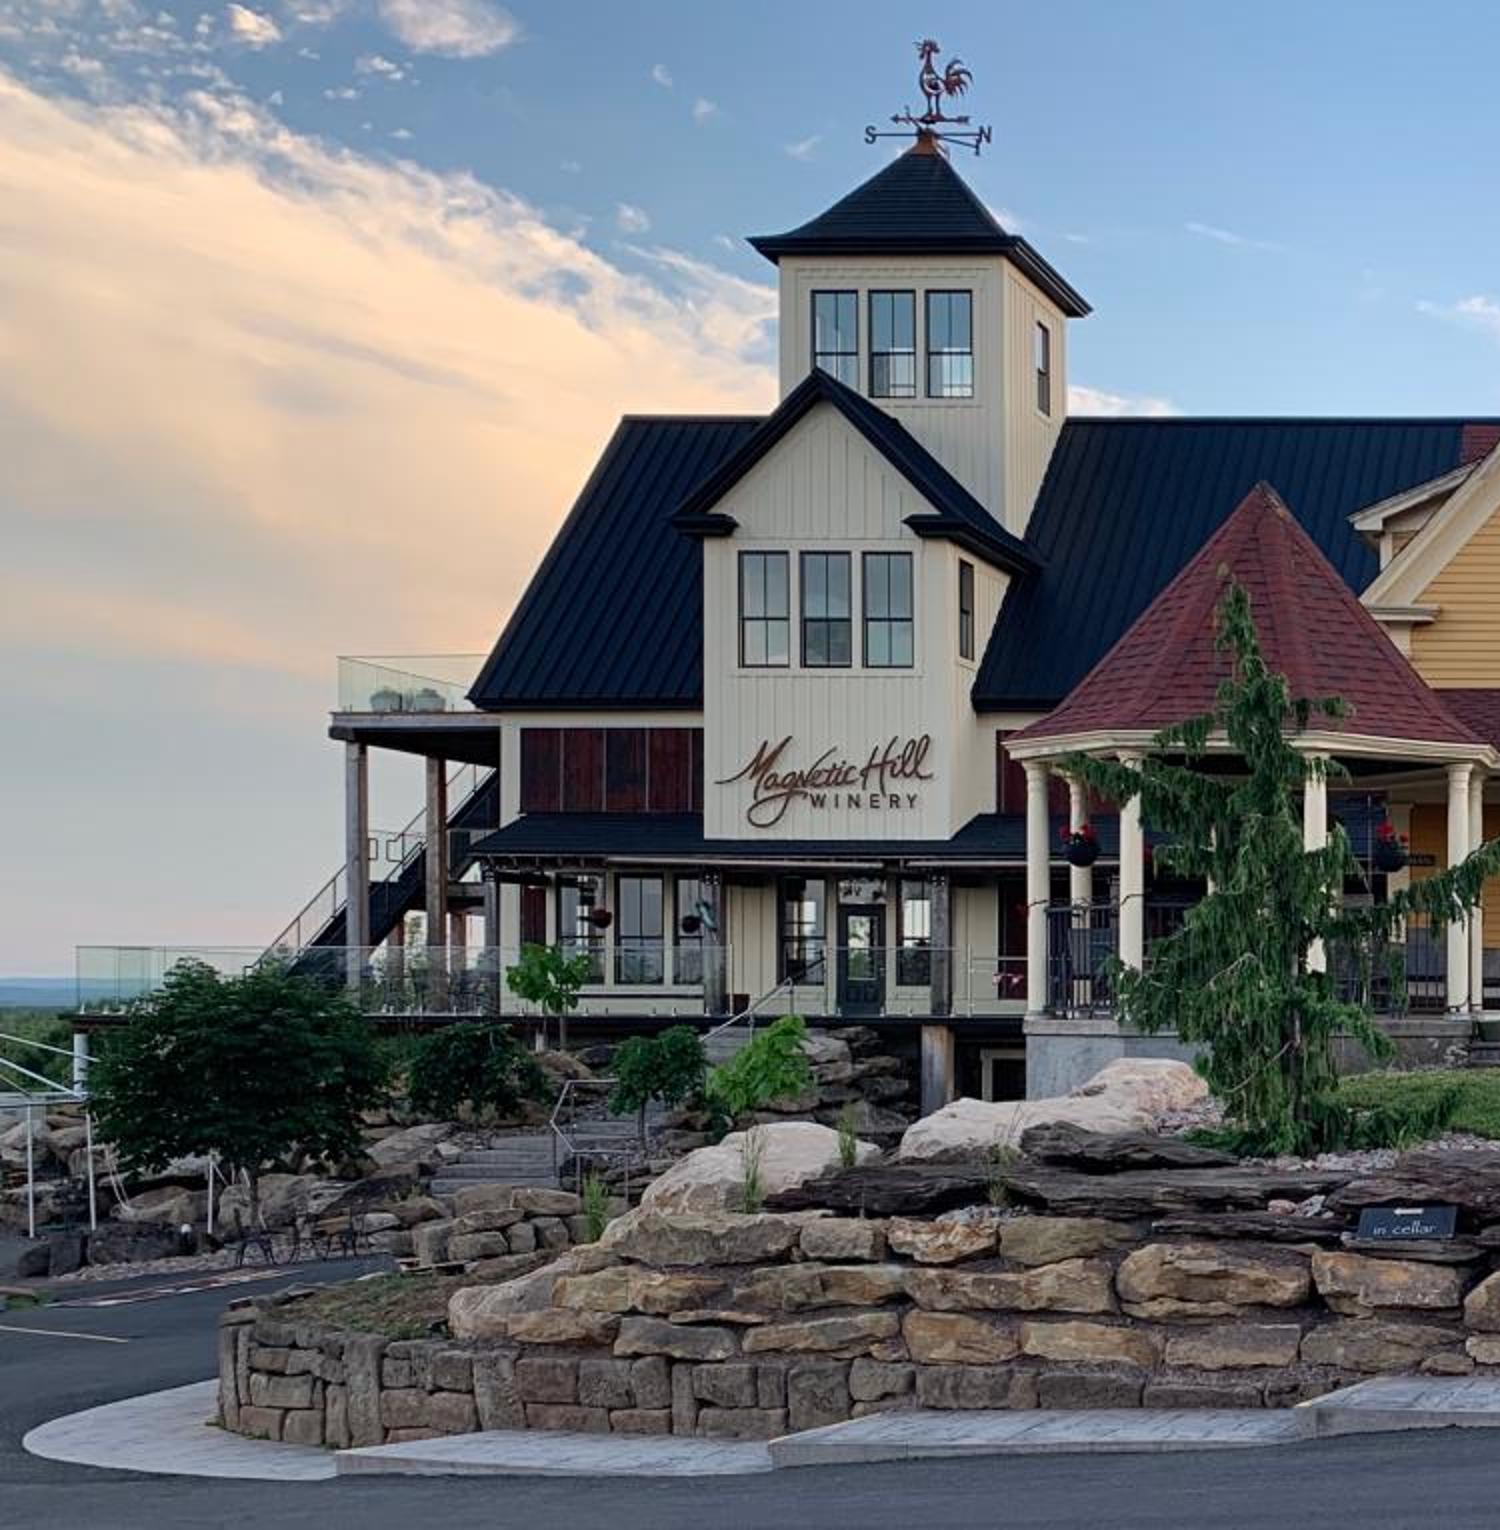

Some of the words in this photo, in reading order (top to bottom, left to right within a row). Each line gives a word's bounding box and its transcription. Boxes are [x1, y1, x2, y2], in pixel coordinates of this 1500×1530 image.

[864, 125, 877, 145] S
[978, 125, 992, 144] N
[714, 735, 858, 828] Magnetic
[860, 734, 933, 797] Hill
[809, 793, 918, 809] WINERY
[1391, 1220, 1437, 1235] cellar
